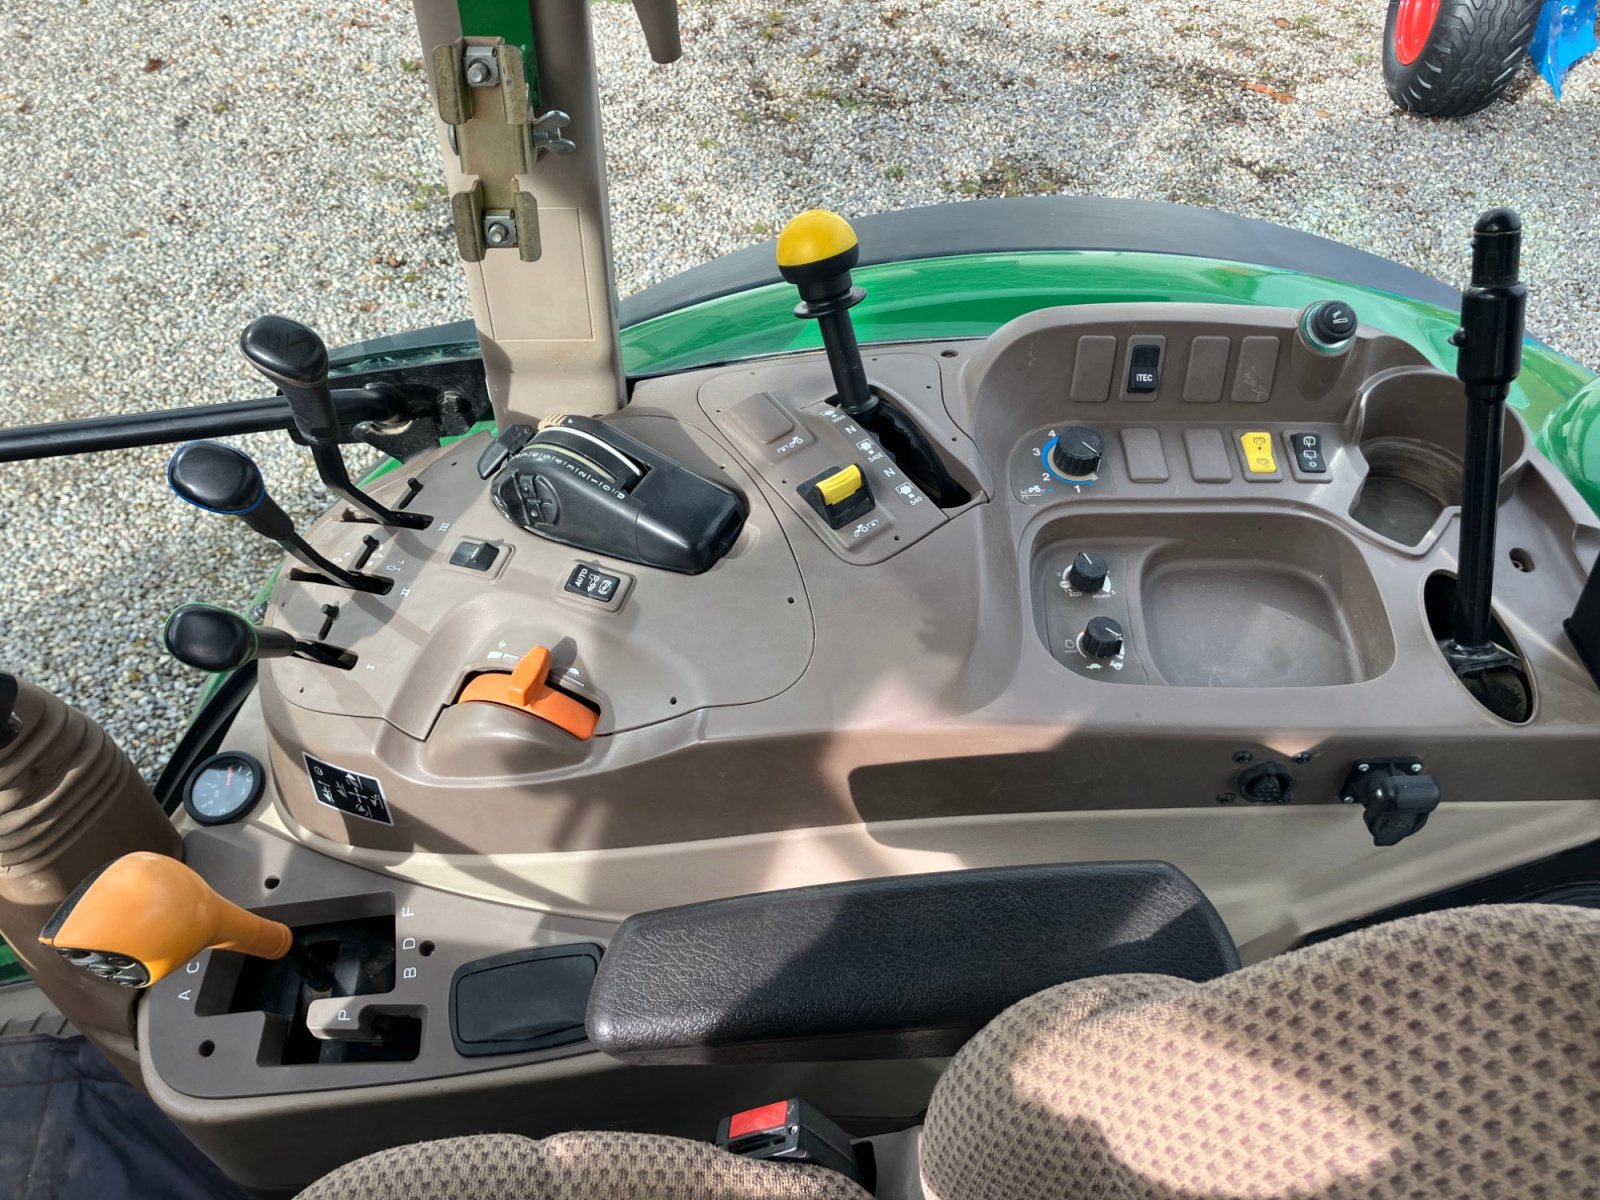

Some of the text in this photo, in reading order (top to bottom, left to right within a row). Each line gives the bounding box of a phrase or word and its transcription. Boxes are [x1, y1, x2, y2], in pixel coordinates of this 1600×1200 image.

[1136, 373, 1153, 382] ITEC
[844, 425, 857, 434] N
[1048, 429, 1057, 438] 4
[1032, 447, 1041, 457] 3
[578, 470, 587, 478] 2
[883, 467, 897, 478] N
[1041, 472, 1051, 481] 2
[1073, 484, 1081, 494] 1
[574, 567, 588, 588] AUTO
[402, 905, 415, 917] F
[402, 937, 416, 950] D
[186, 961, 200, 974] C
[403, 966, 417, 979] B
[177, 989, 191, 1001] A
[337, 1009, 351, 1021] P
